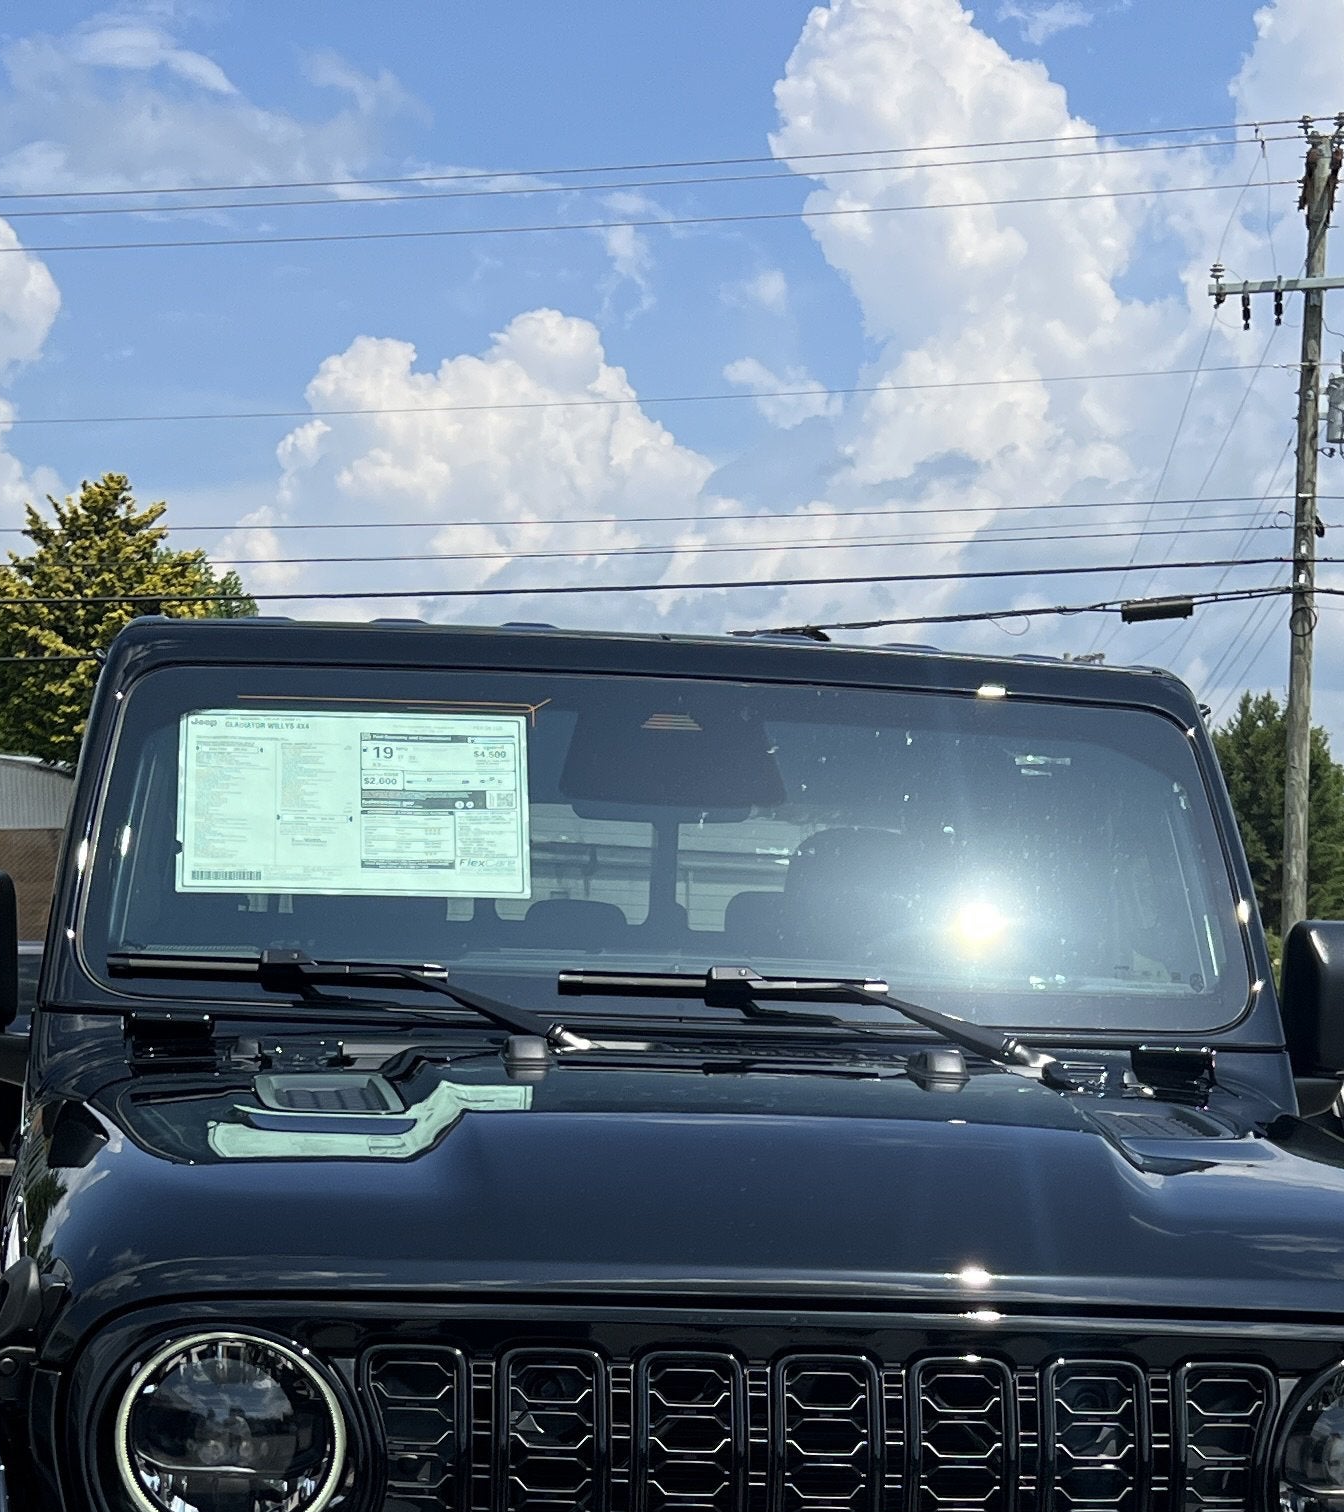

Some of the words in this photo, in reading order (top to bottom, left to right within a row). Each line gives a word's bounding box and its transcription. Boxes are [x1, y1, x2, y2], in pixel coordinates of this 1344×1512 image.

[191, 717, 218, 728] Jeep
[224, 721, 266, 729] GLADIATOR
[267, 721, 294, 730] WILLYS
[373, 746, 394, 760] 19
[473, 750, 507, 759] $4,500
[363, 777, 398, 786] $2,000
[460, 858, 516, 868] FlexCare
